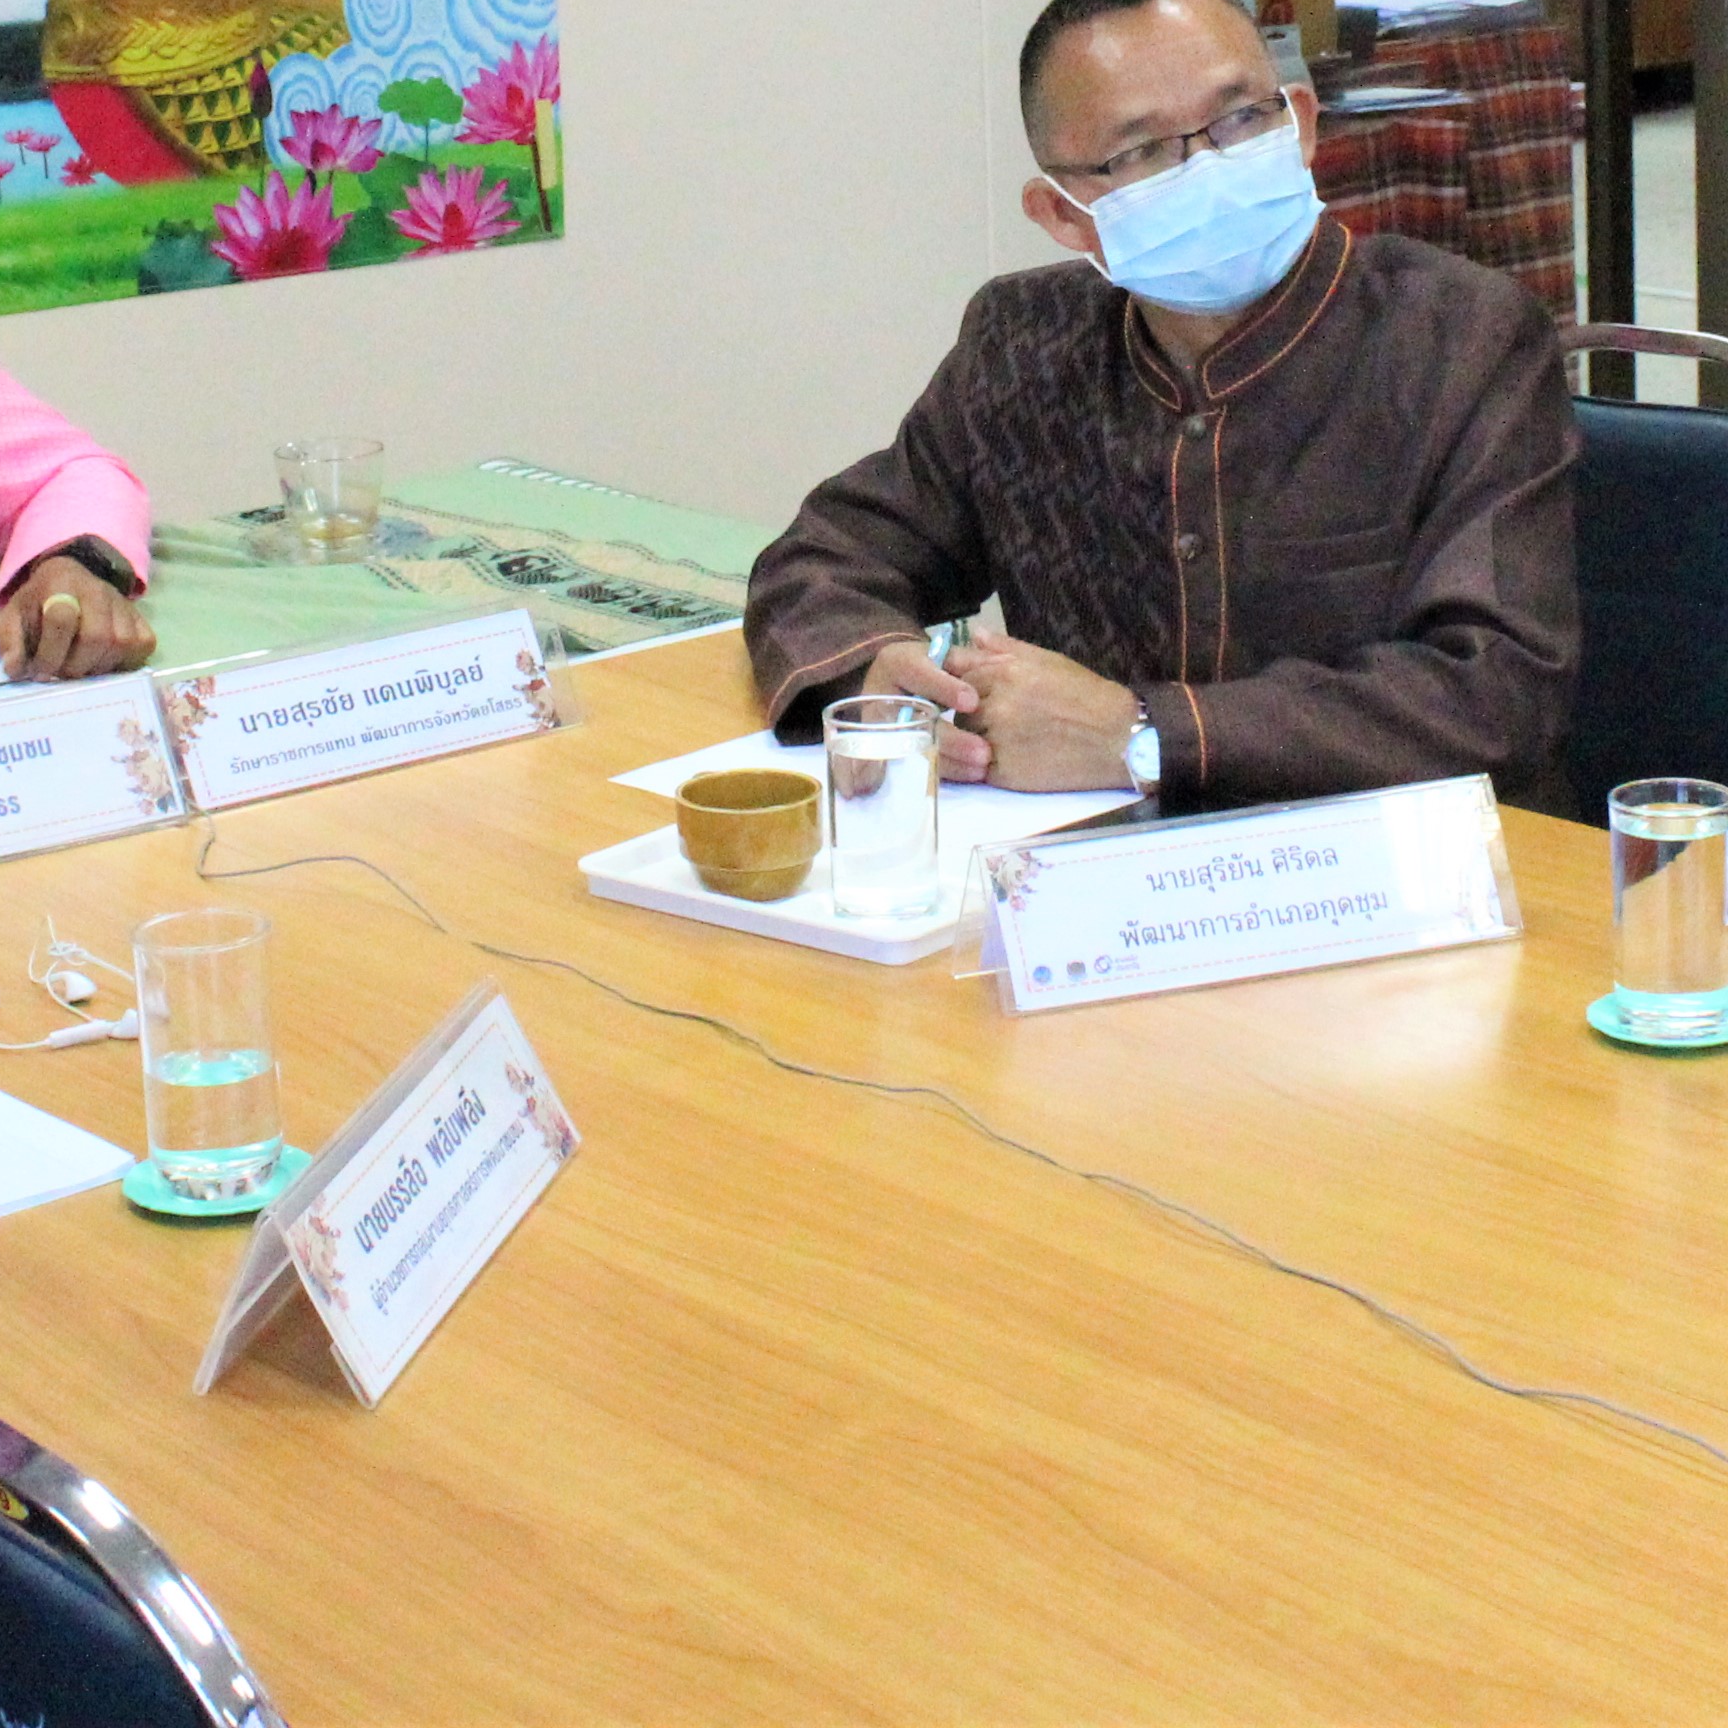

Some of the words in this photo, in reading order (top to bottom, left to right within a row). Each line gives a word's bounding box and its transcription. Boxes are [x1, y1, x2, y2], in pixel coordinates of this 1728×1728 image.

[239, 686, 356, 735] นายสุรชัย
[362, 654, 485, 707] แดนพิบูลย์
[229, 733, 357, 775] รักษาราชการแทน
[360, 694, 523, 745] พัฒนาการจังหวัดยโสธร
[1145, 851, 1265, 894] นายสุริยัน
[1270, 844, 1340, 874] ศิริดล
[1118, 889, 1390, 949] พัฒนาการอำเภอกุดชุม
